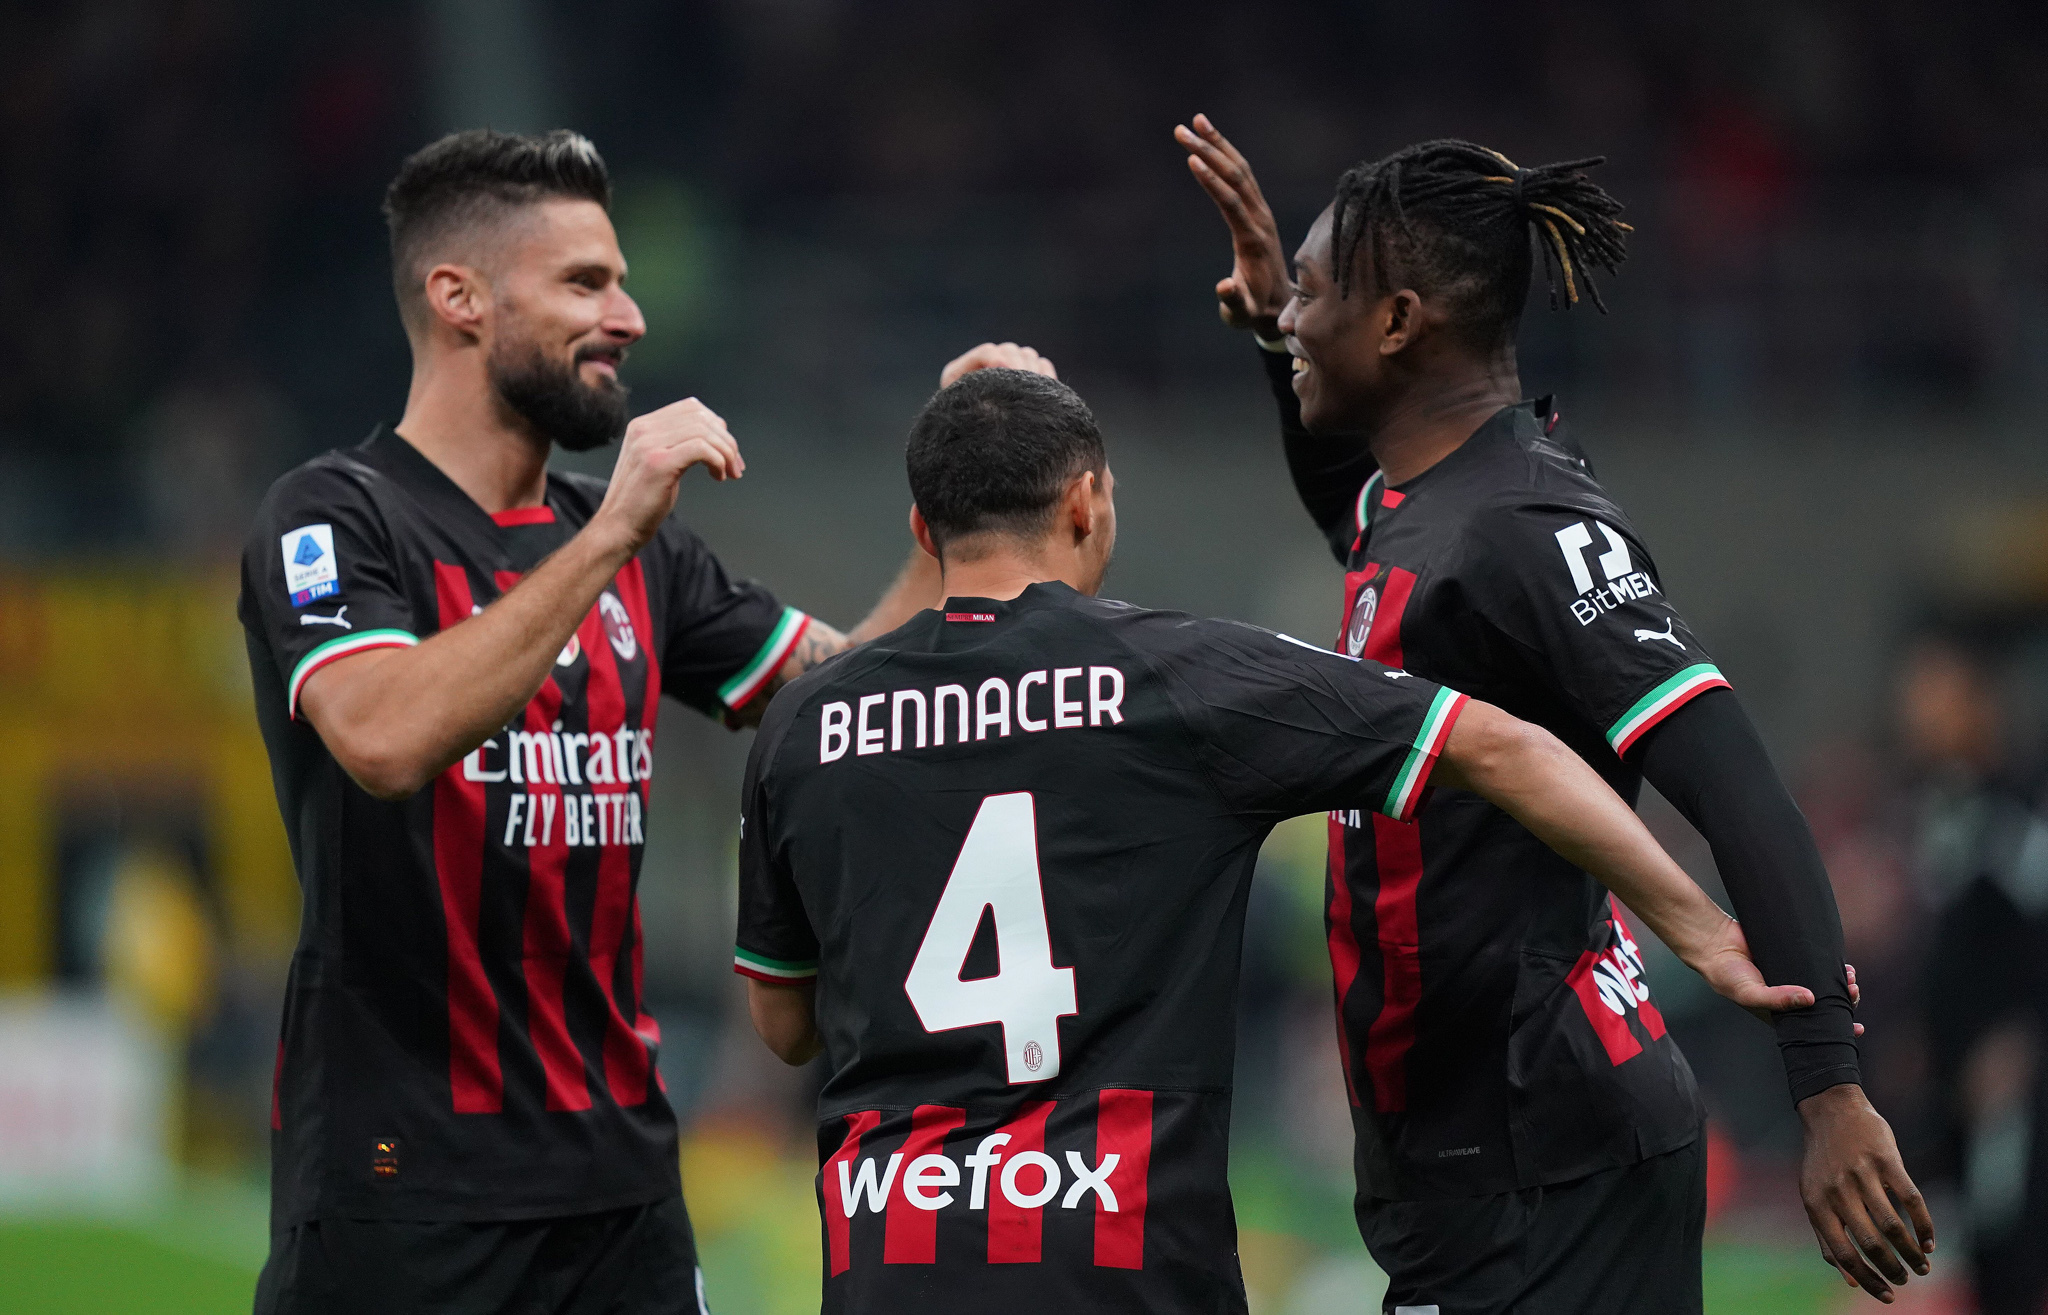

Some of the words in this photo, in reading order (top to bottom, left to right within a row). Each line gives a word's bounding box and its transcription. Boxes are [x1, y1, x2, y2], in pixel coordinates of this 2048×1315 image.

[310, 581, 334, 598] TIM
[1570, 572, 1663, 626] BitMEX
[820, 666, 1125, 764] BENNACER
[503, 793, 556, 846] FLY
[564, 792, 644, 847] BETTER
[903, 790, 1079, 1085] 4
[837, 1132, 1121, 1219] wefox
